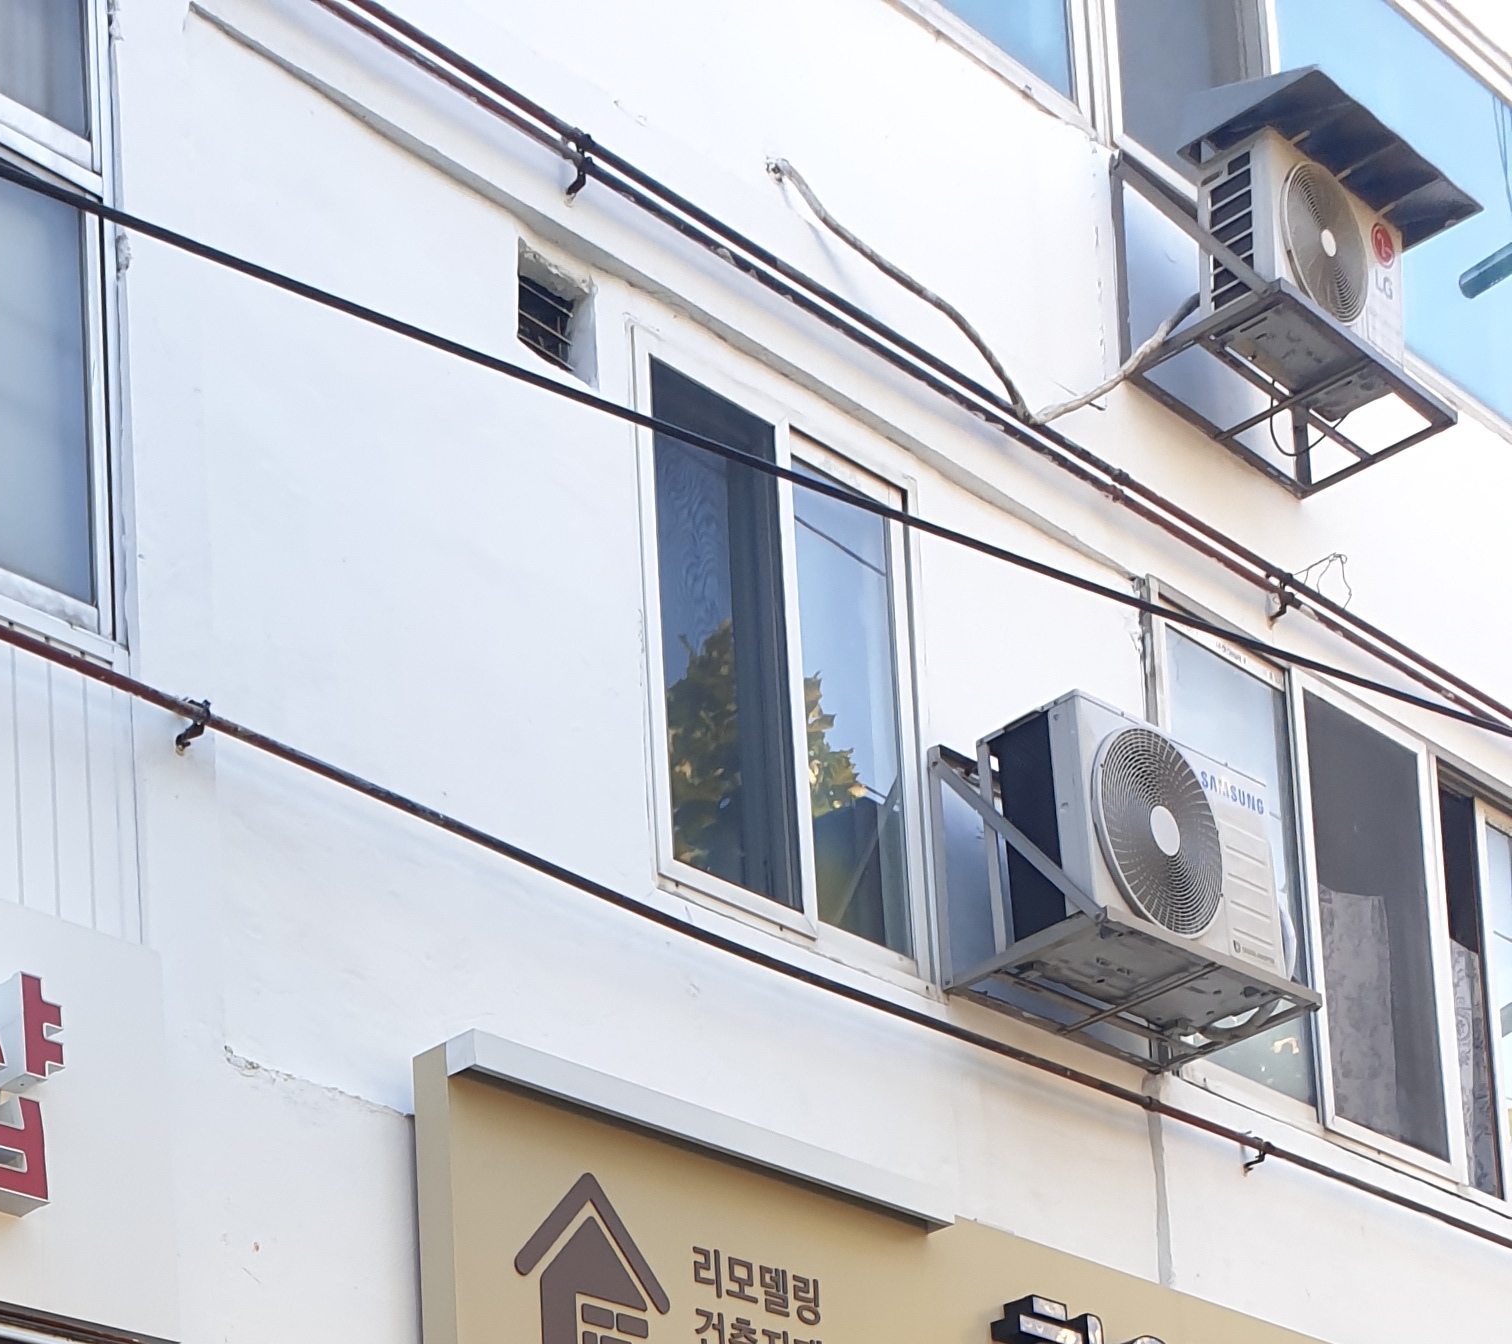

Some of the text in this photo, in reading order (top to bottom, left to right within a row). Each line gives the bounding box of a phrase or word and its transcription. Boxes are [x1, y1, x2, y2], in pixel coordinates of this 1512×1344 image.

[1374, 268, 1393, 300] LG
[1200, 771, 1264, 815] SAMSUNG
[692, 1245, 821, 1326] 리모델링
